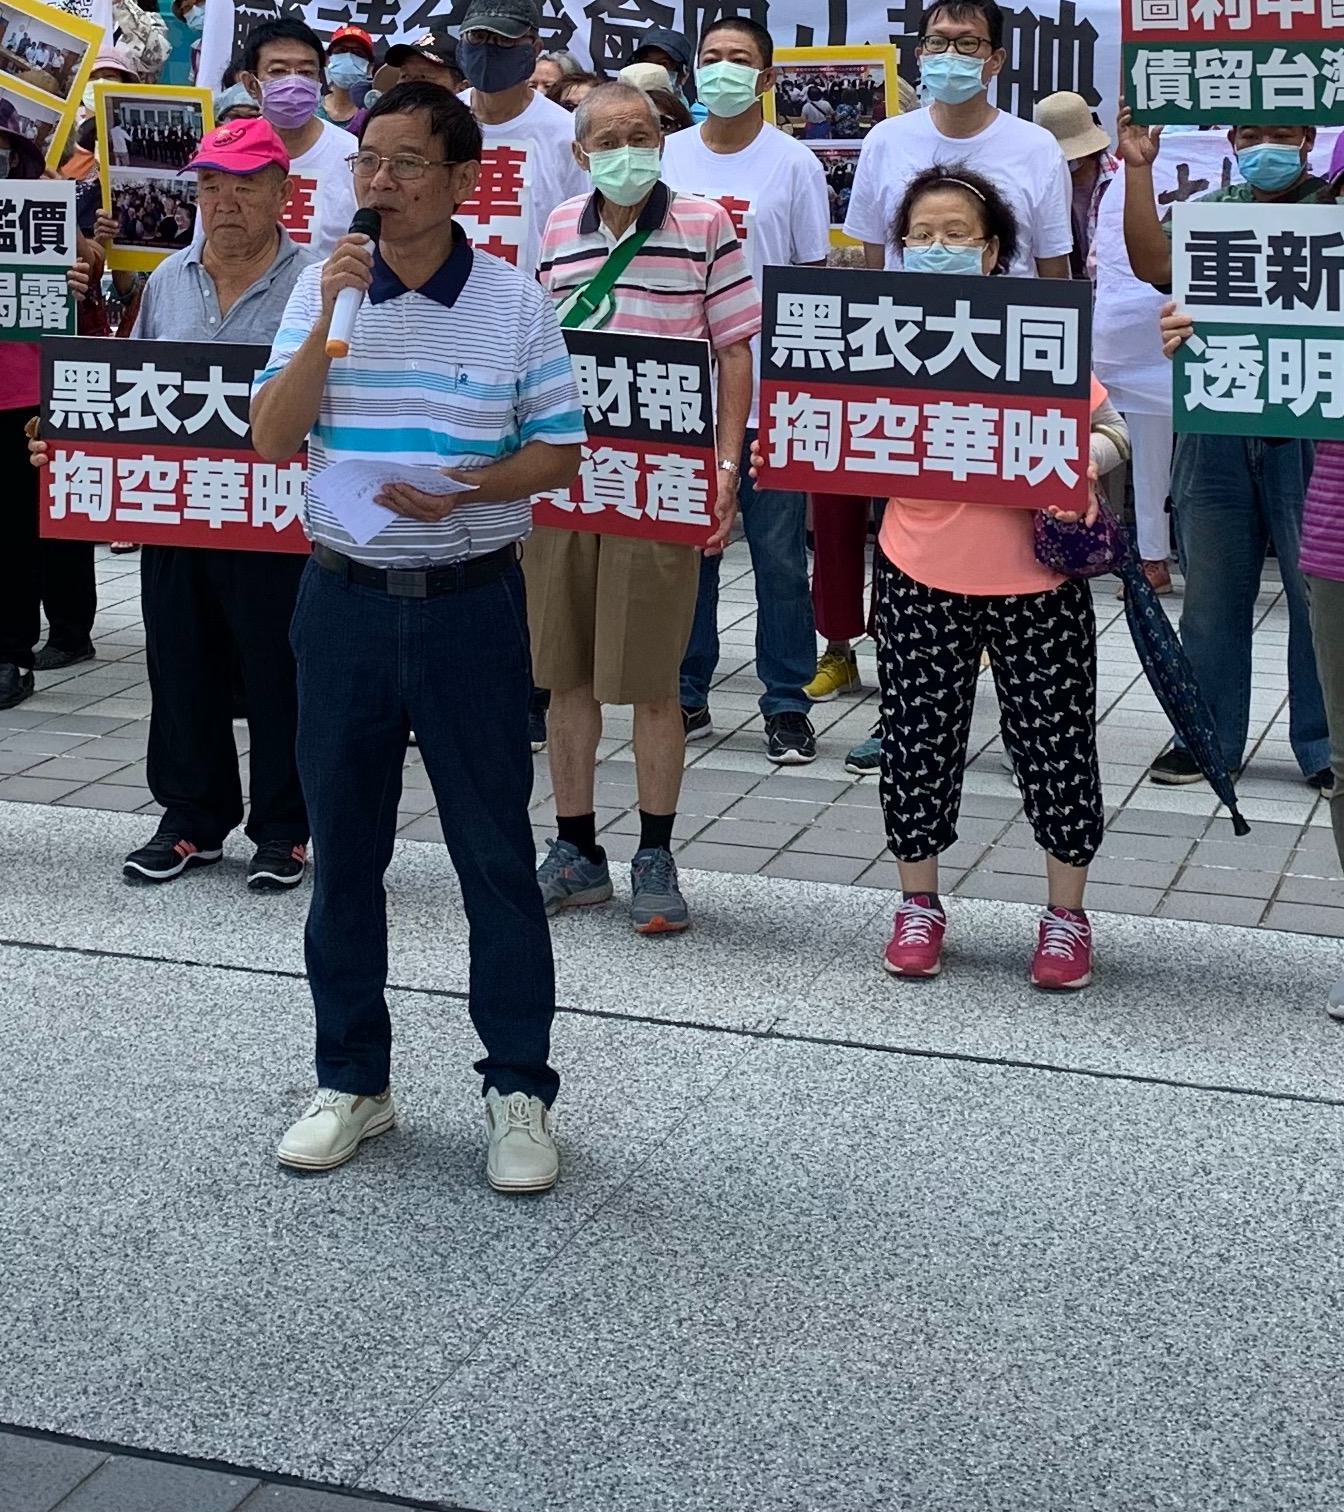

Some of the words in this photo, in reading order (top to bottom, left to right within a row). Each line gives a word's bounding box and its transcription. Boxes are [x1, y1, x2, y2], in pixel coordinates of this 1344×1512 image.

[770, 292, 1080, 386] 黑衣大同
[49, 360, 266, 437] 黑衣大
[570, 354, 707, 435] 財報
[768, 391, 1080, 489] 掏空華映
[49, 450, 308, 533] 掏空華映
[530, 445, 712, 527] 資產
